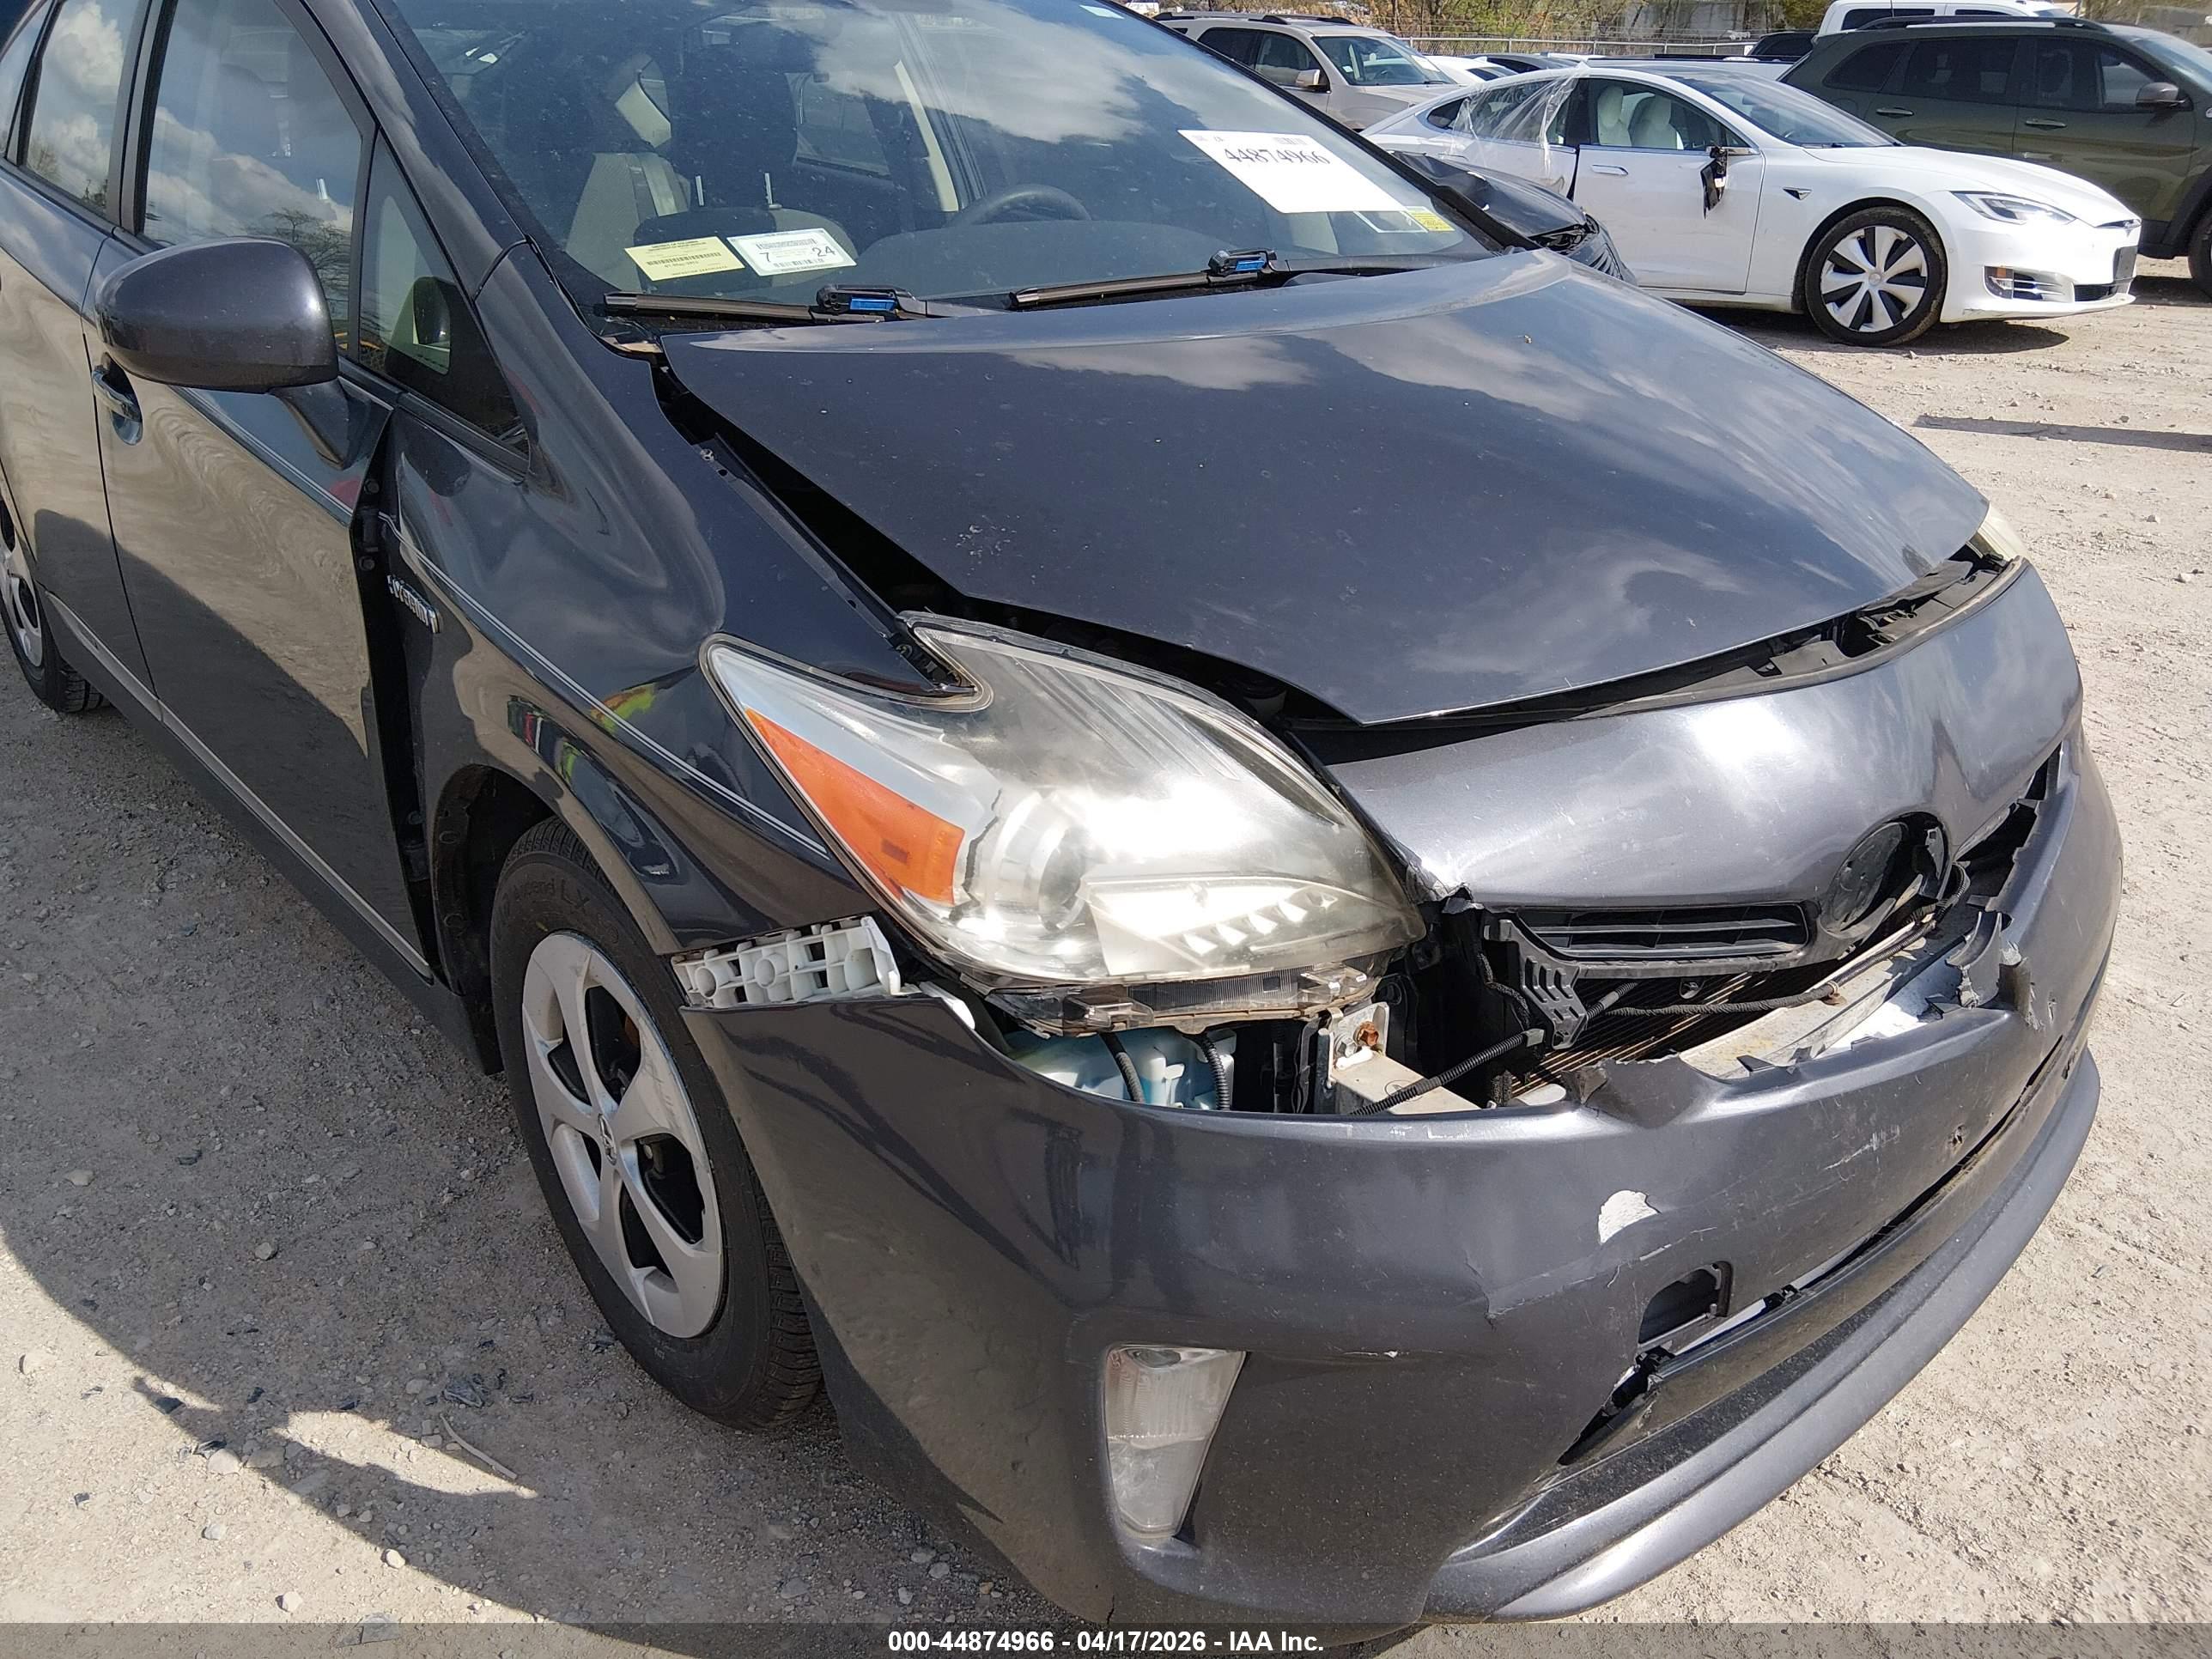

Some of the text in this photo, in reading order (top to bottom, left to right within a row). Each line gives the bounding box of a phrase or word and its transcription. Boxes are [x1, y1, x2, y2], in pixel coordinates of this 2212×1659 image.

[1224, 148, 1331, 165] 44874966
[758, 252, 771, 263] 7
[811, 246, 836, 258] 24
